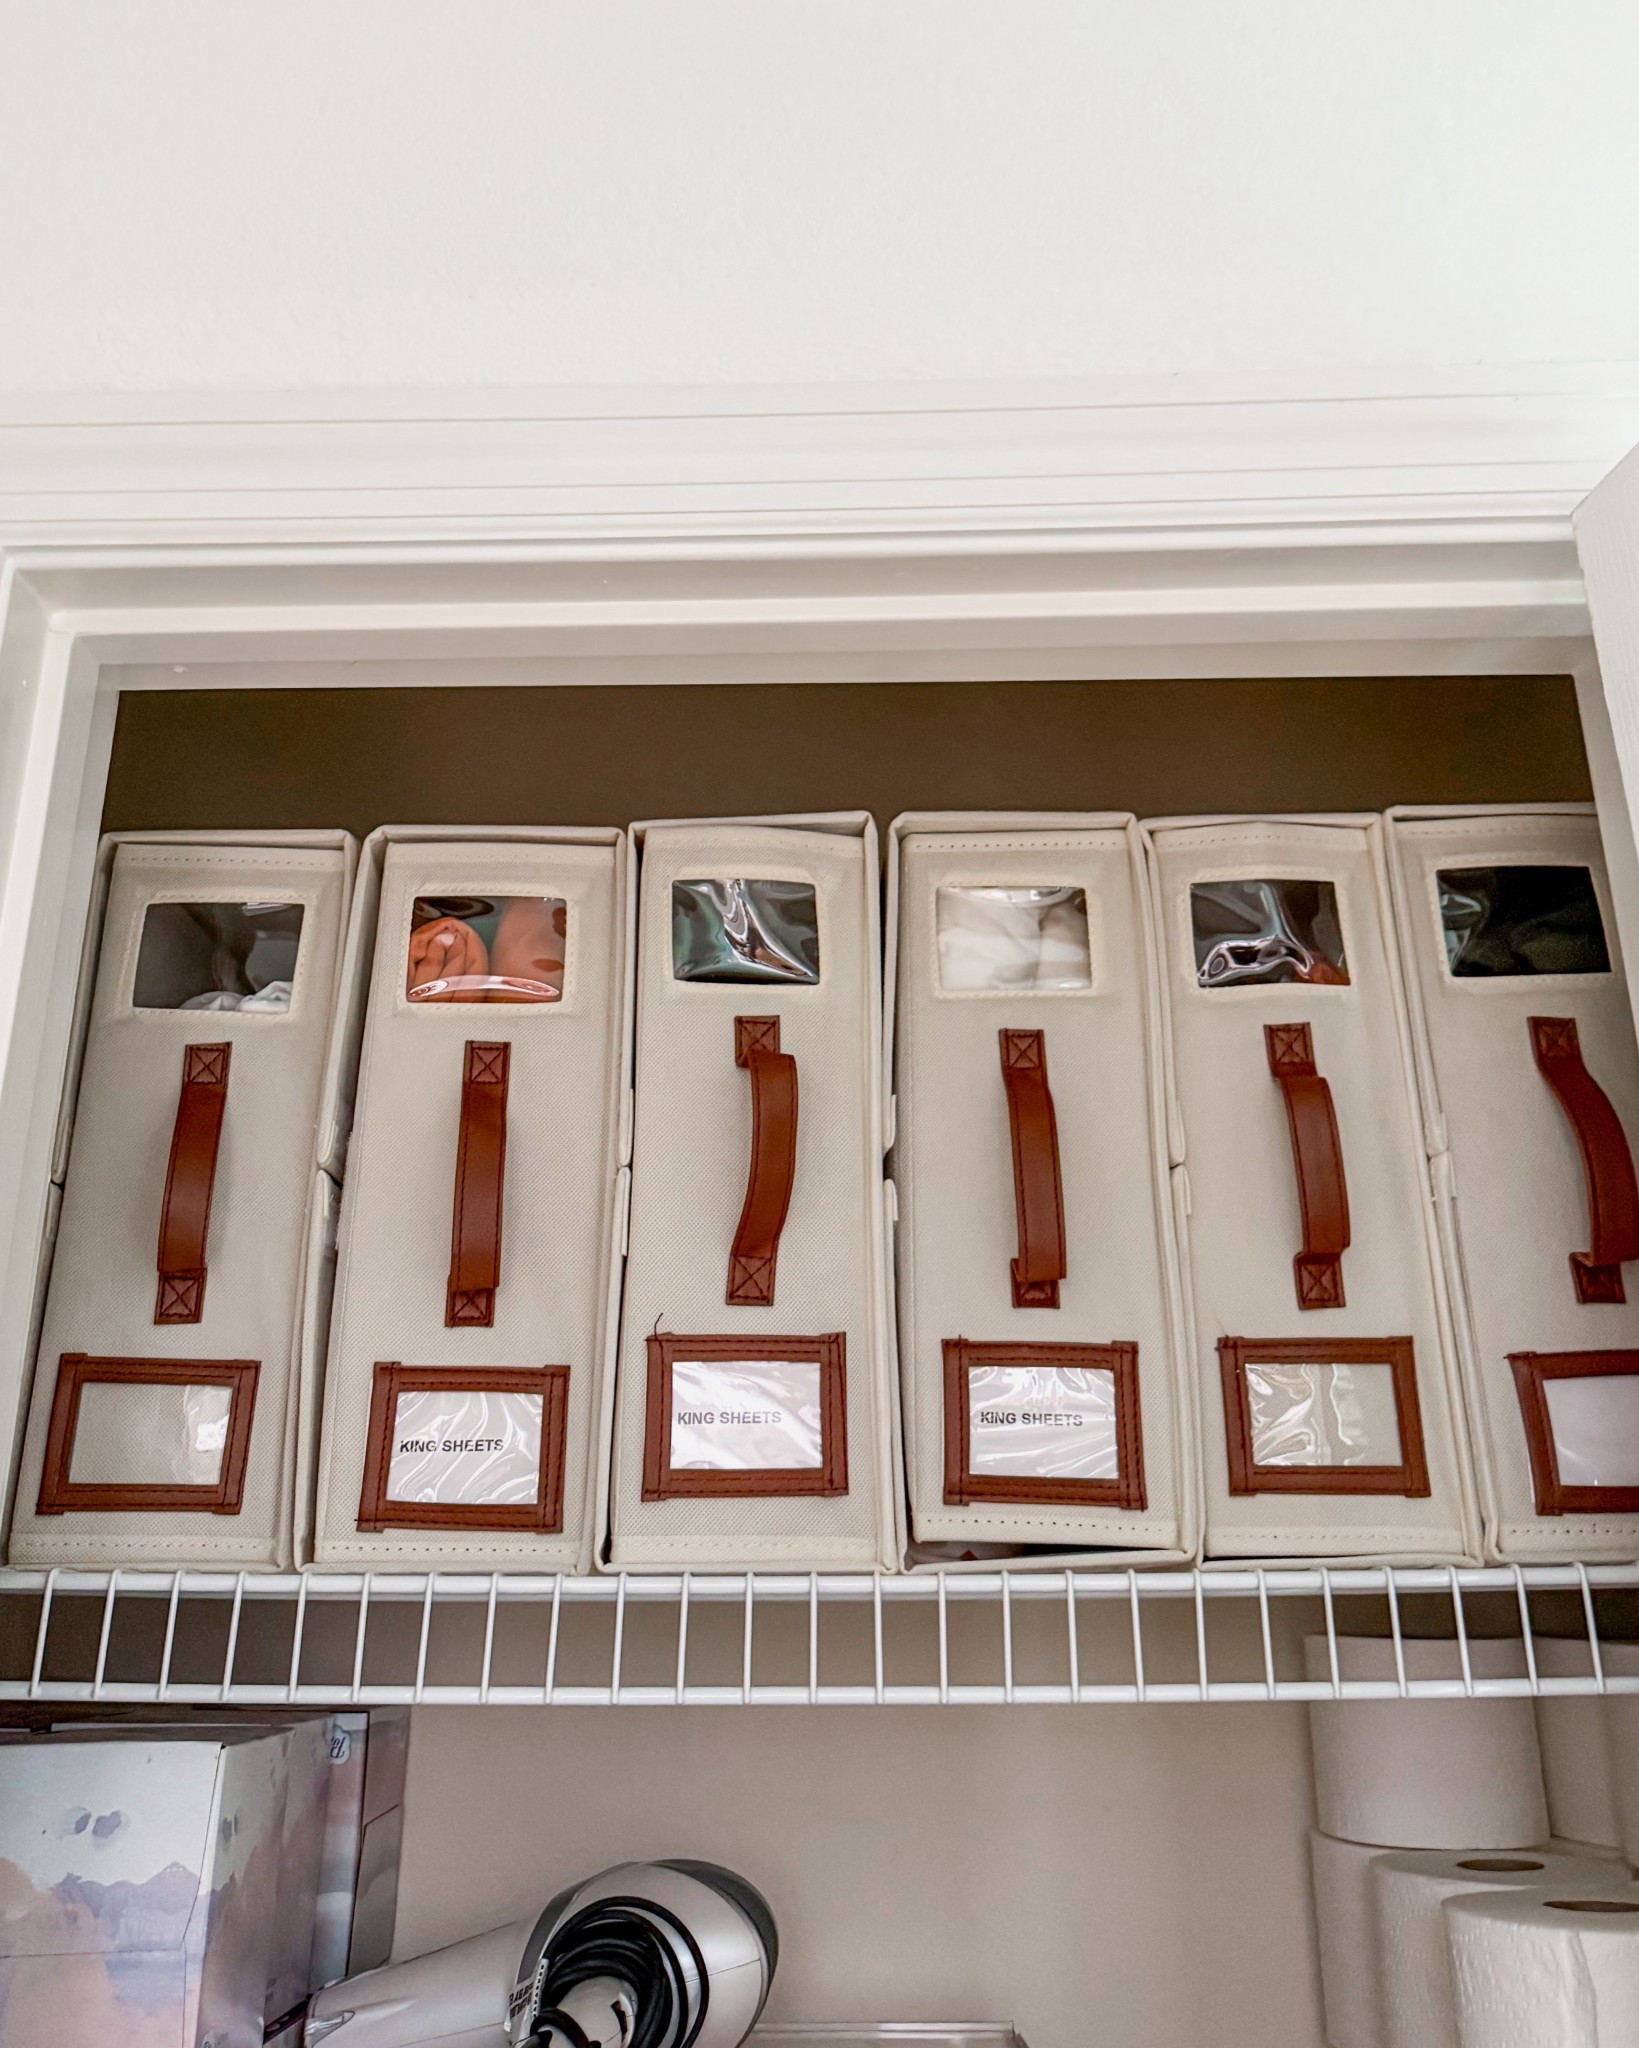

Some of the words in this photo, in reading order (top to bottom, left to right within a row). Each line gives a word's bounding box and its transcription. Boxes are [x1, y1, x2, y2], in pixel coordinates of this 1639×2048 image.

[677, 1412, 715, 1425] KING
[720, 1411, 782, 1424] SHEETS
[980, 1411, 1016, 1424] KING
[1021, 1413, 1083, 1426] SHEETS
[400, 1440, 437, 1453] KING
[442, 1439, 504, 1452] SHEETS
